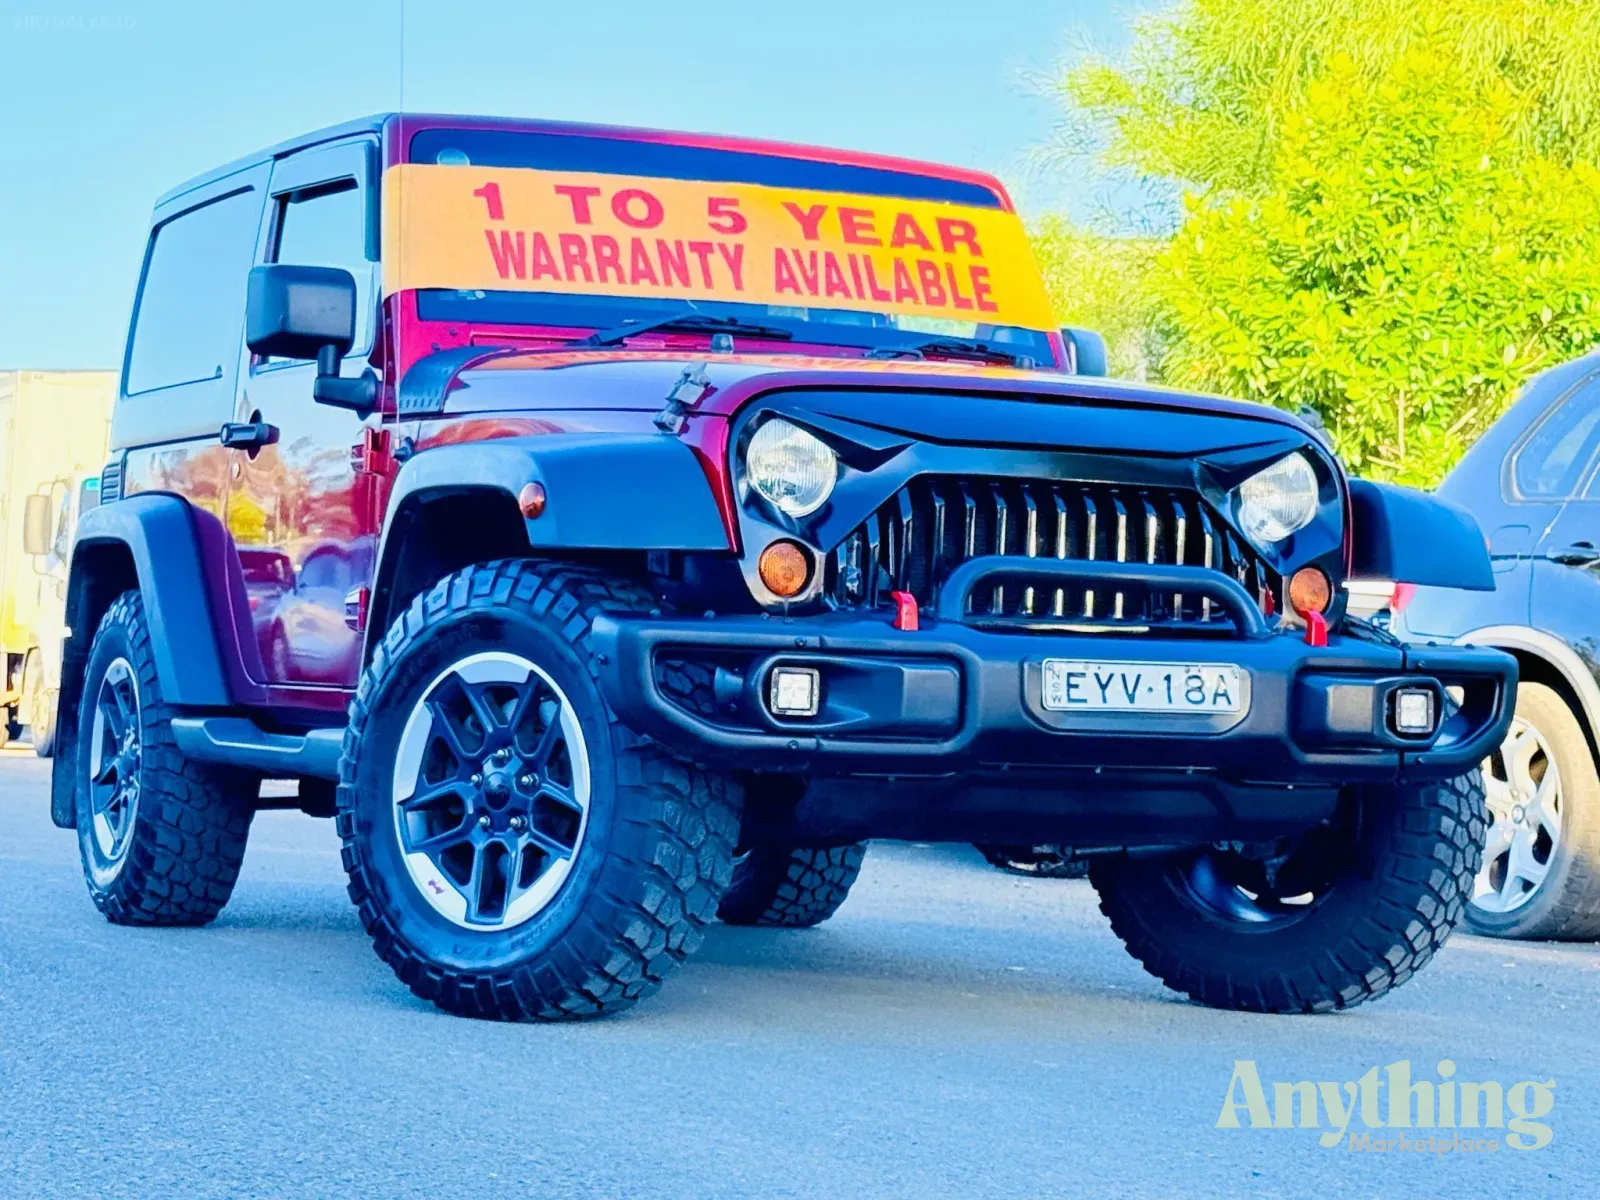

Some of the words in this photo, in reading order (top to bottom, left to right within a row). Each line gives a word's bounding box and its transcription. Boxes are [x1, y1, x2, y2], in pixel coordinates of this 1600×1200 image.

[473, 182, 505, 220] 1
[555, 185, 665, 229] TO
[707, 196, 748, 235] 5
[783, 202, 983, 256] YEAR
[485, 230, 744, 291] WARRANTY
[774, 247, 998, 312] AVAILABLE
